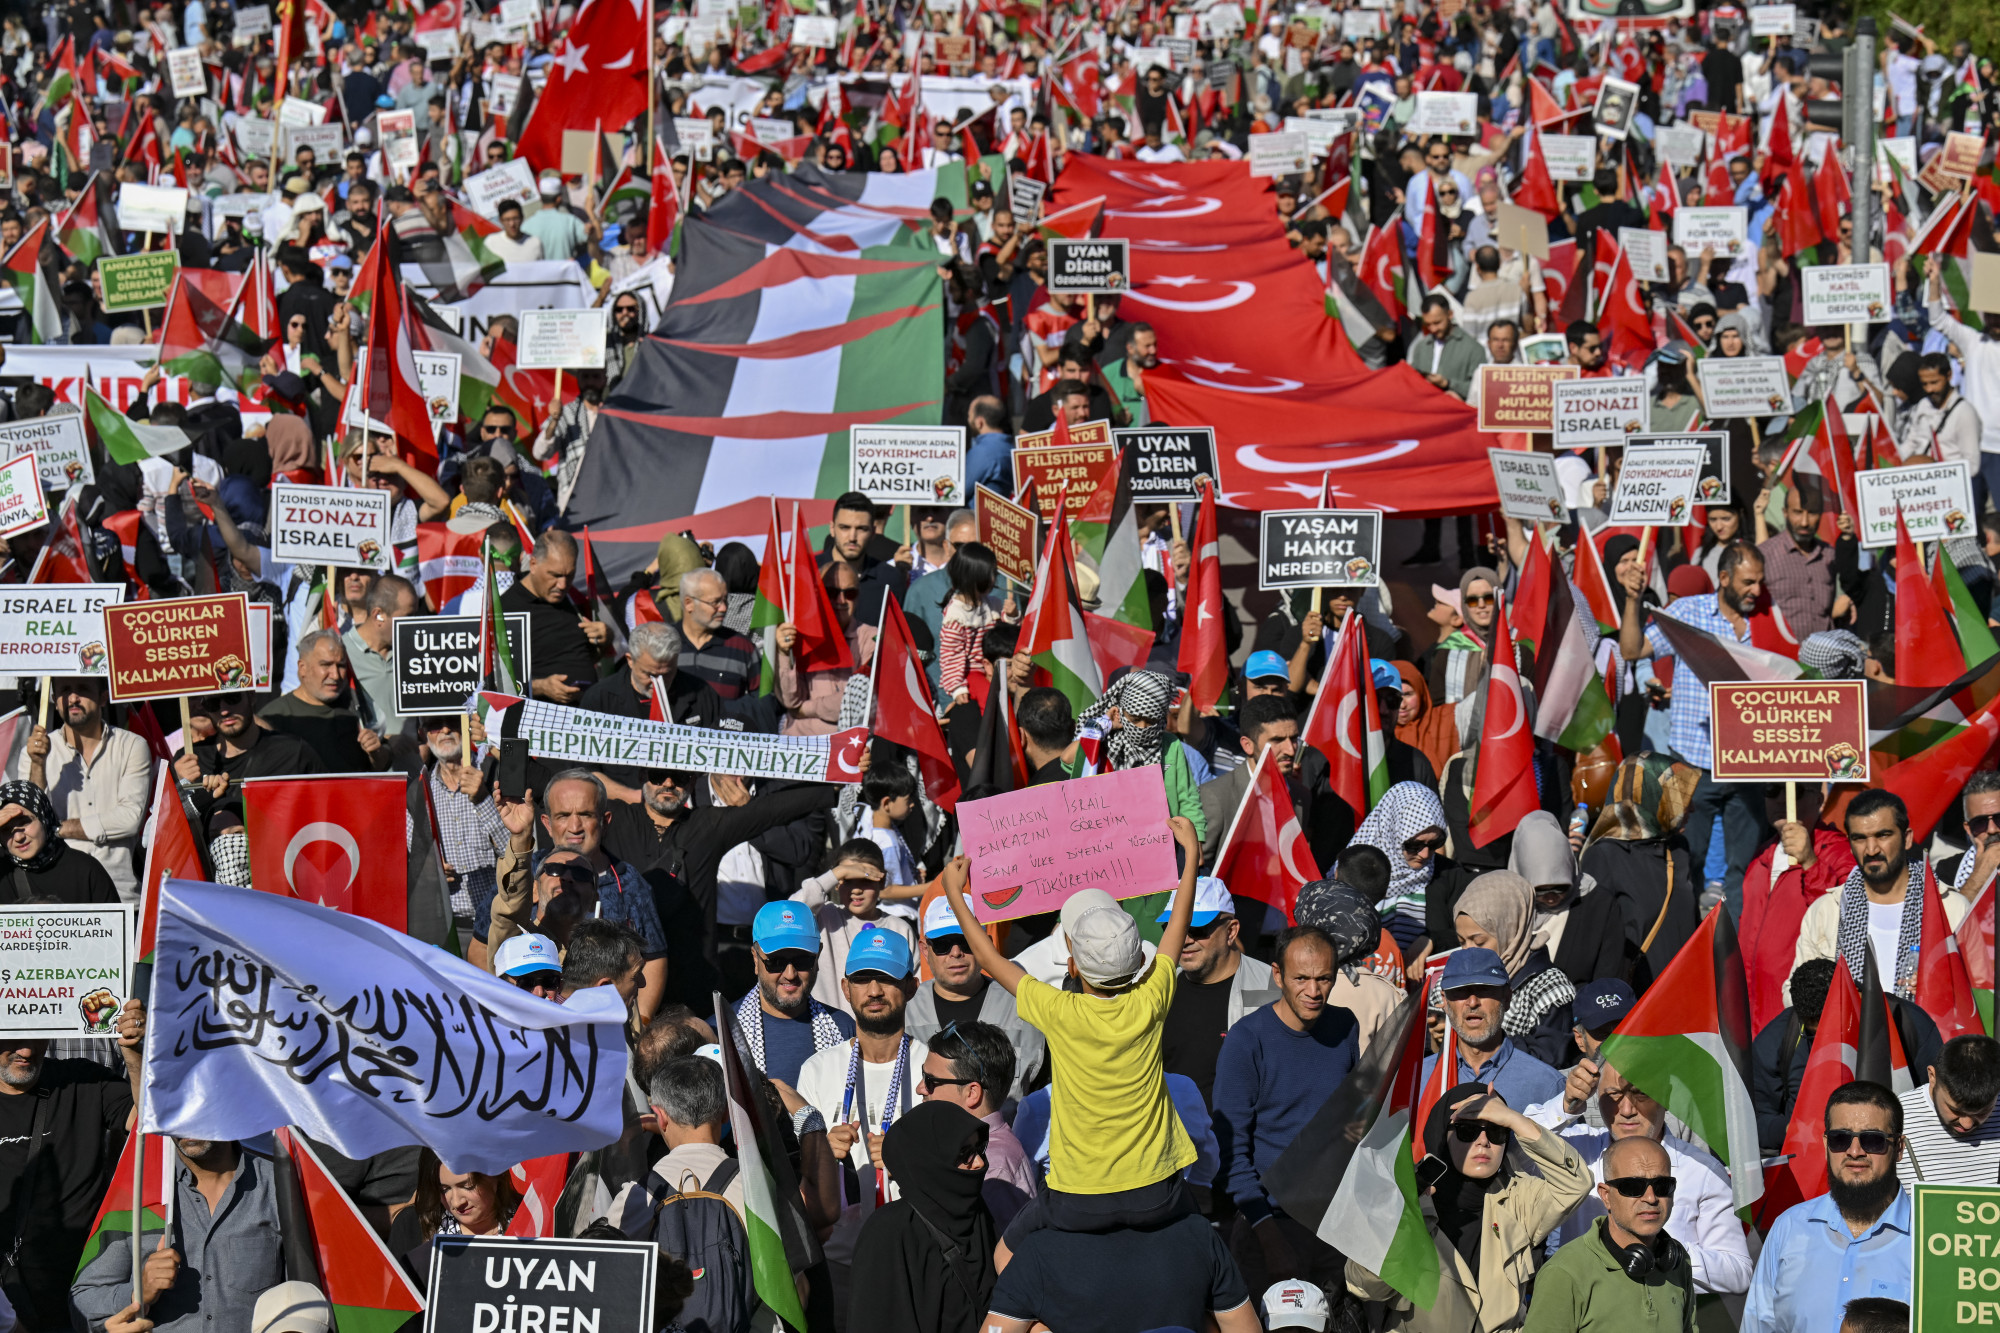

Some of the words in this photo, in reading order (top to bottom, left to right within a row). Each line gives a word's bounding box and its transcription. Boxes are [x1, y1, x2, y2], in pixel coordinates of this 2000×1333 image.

[1068, 245, 1110, 259] UYAN
[105, 256, 173, 272] ANKARA'DAN
[1065, 258, 1113, 274] DİREN
[116, 267, 165, 281] GAZZE'YE
[431, 363, 449, 377] IS
[1509, 385, 1548, 396] ZAFER
[1560, 388, 1596, 398] ZIONIST
[1600, 386, 1619, 396] AND
[1564, 397, 1639, 414] ZIONAZI
[0, 424, 62, 441] SİYONİST
[1560, 417, 1622, 433] ISRAEL
[15, 438, 54, 454] KATİL
[858, 439, 888, 447] ADALET
[889, 439, 899, 447] VE
[900, 439, 928, 447] HUKUK
[1138, 436, 1191, 452] UYAN
[858, 448, 957, 460] SOYKIRIMCILAR
[1026, 451, 1105, 468] FİLİSTİN'DE
[858, 462, 924, 476] YARGI-
[1137, 453, 1198, 473] DİREN
[1499, 460, 1536, 476] ISRAEL
[1537, 467, 1550, 477] IS
[1046, 467, 1088, 481] ZAFER
[1625, 469, 1694, 480] SOYKIRIMCILAR
[1868, 468, 1957, 487] VİCDANLARIN
[858, 478, 931, 492] LANSIN!
[1623, 483, 1667, 496] YARGI-
[1891, 485, 1937, 500] İSYANI
[280, 495, 326, 506] ZIONIST
[330, 498, 353, 508] AND
[356, 500, 383, 510] NAZI
[1618, 499, 1670, 513] LANSIN!
[285, 507, 377, 528] ZIONAZI
[983, 496, 1027, 531] NEHİRDEN
[990, 517, 1020, 544] DENİZE
[1282, 518, 1359, 539] YAŞAM
[1870, 516, 1938, 533] YENCEK!
[280, 530, 356, 549] ISRAEL
[991, 533, 1020, 559] ÖZGÜR
[1284, 539, 1356, 557] HAKKI
[1268, 561, 1342, 578] NEREDE?
[3, 599, 77, 614] ISRAEL
[84, 599, 105, 613] IS
[122, 604, 225, 628] ÇOCUKLAR
[25, 620, 77, 636] REAL
[132, 623, 219, 645] ÖLÜRKEN
[0, 642, 80, 655] ERRORIST
[145, 643, 211, 663] SESSİZ
[117, 663, 212, 686] KALMAYIN
[402, 681, 483, 695] İSTEMİYORU
[1731, 690, 1841, 709] ÇOCUKLAR
[572, 714, 622, 730] DAYAN
[1740, 706, 1833, 724] ÖLÜRKEN
[1752, 724, 1822, 743] SESSİZ
[528, 728, 639, 760] HEPİMİZ
[647, 736, 822, 776] FİLİSTİNLİYİZ
[1721, 749, 1823, 764] KALMAYIN
[979, 806, 1049, 834] YIKILASIN
[983, 864, 1019, 879] SANA
[1030, 854, 1055, 869] ÜLKE
[38, 917, 102, 929] ÇOCUKLAR
[35, 929, 114, 941] ÇOCUKLARIN
[15, 968, 120, 981] AZERBAYCAN
[8, 1003, 63, 1015] KAPAT!
[1956, 1201, 2000, 1225] SO
[485, 1256, 597, 1293] UYAN
[1958, 1267, 2000, 1292] BO
[472, 1294, 602, 1333] DİREN
